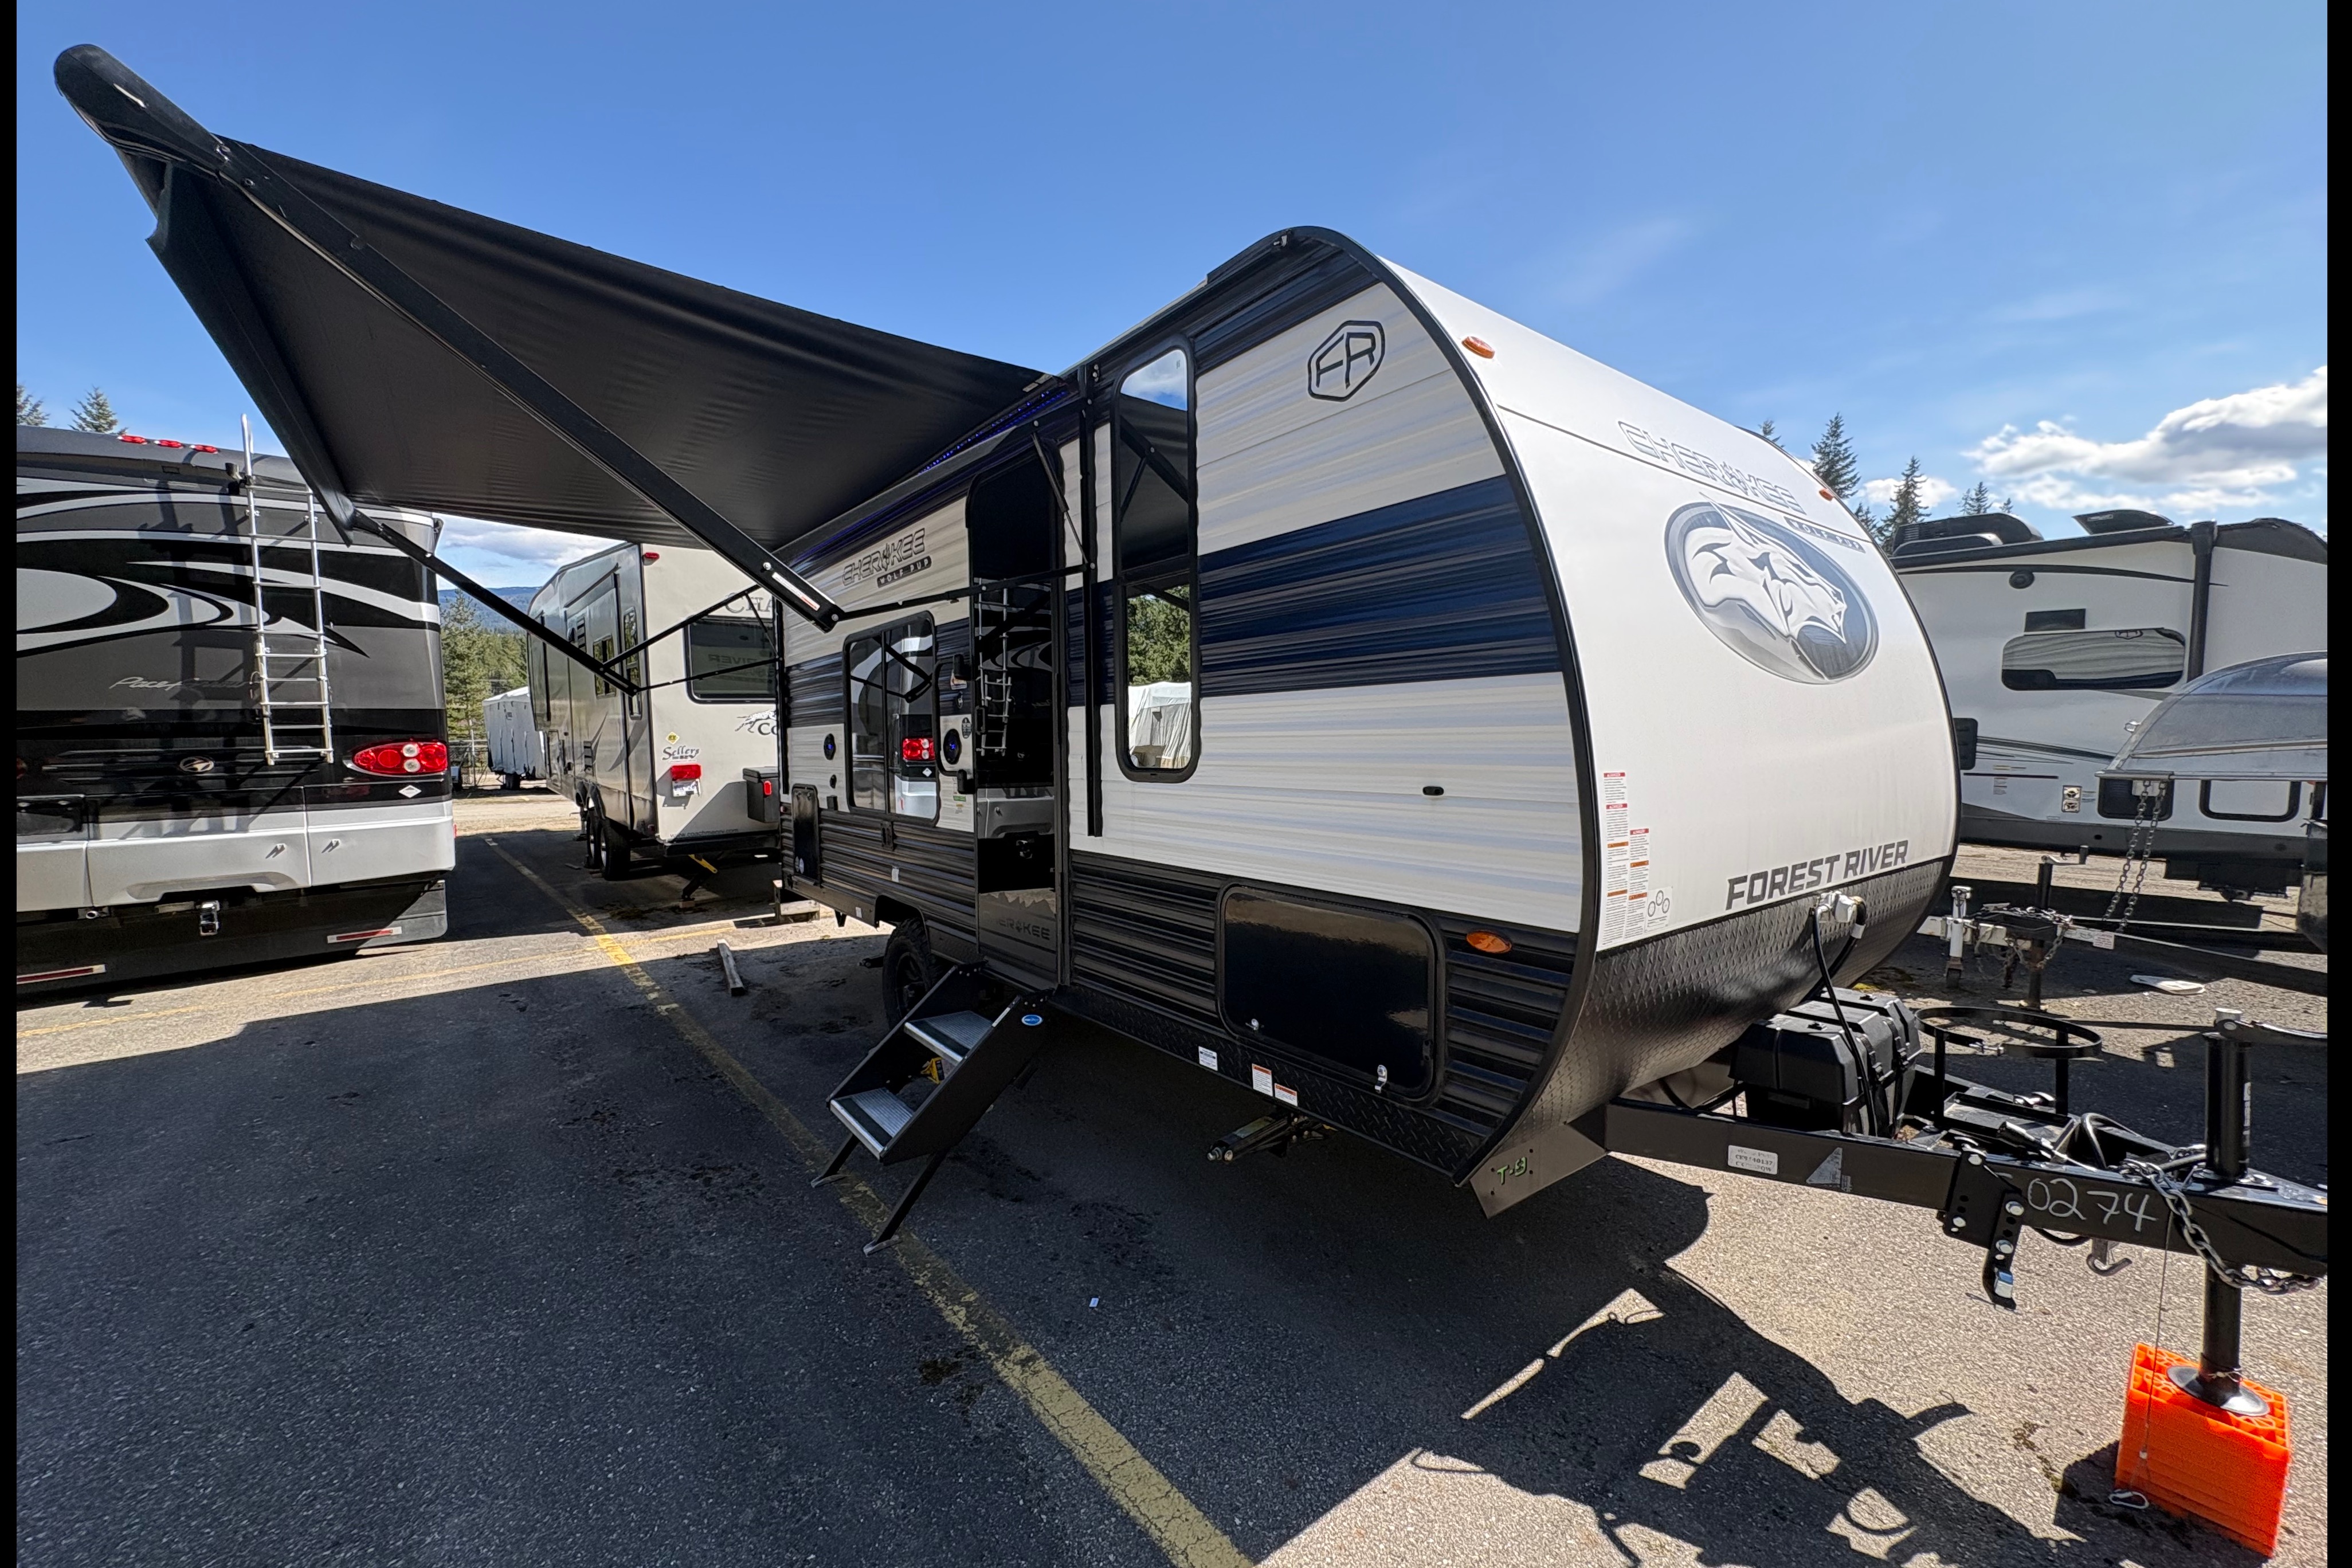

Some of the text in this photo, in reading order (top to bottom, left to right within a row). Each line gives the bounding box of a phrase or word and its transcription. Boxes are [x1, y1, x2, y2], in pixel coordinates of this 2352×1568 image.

[1791, 520, 1859, 549] WOLF PUP
[880, 559, 929, 584] WOLF PUP
[662, 745, 700, 761] Sellers
[1725, 840, 1908, 911] FOREST RIVER
[2027, 1178, 2159, 1232] 0274
